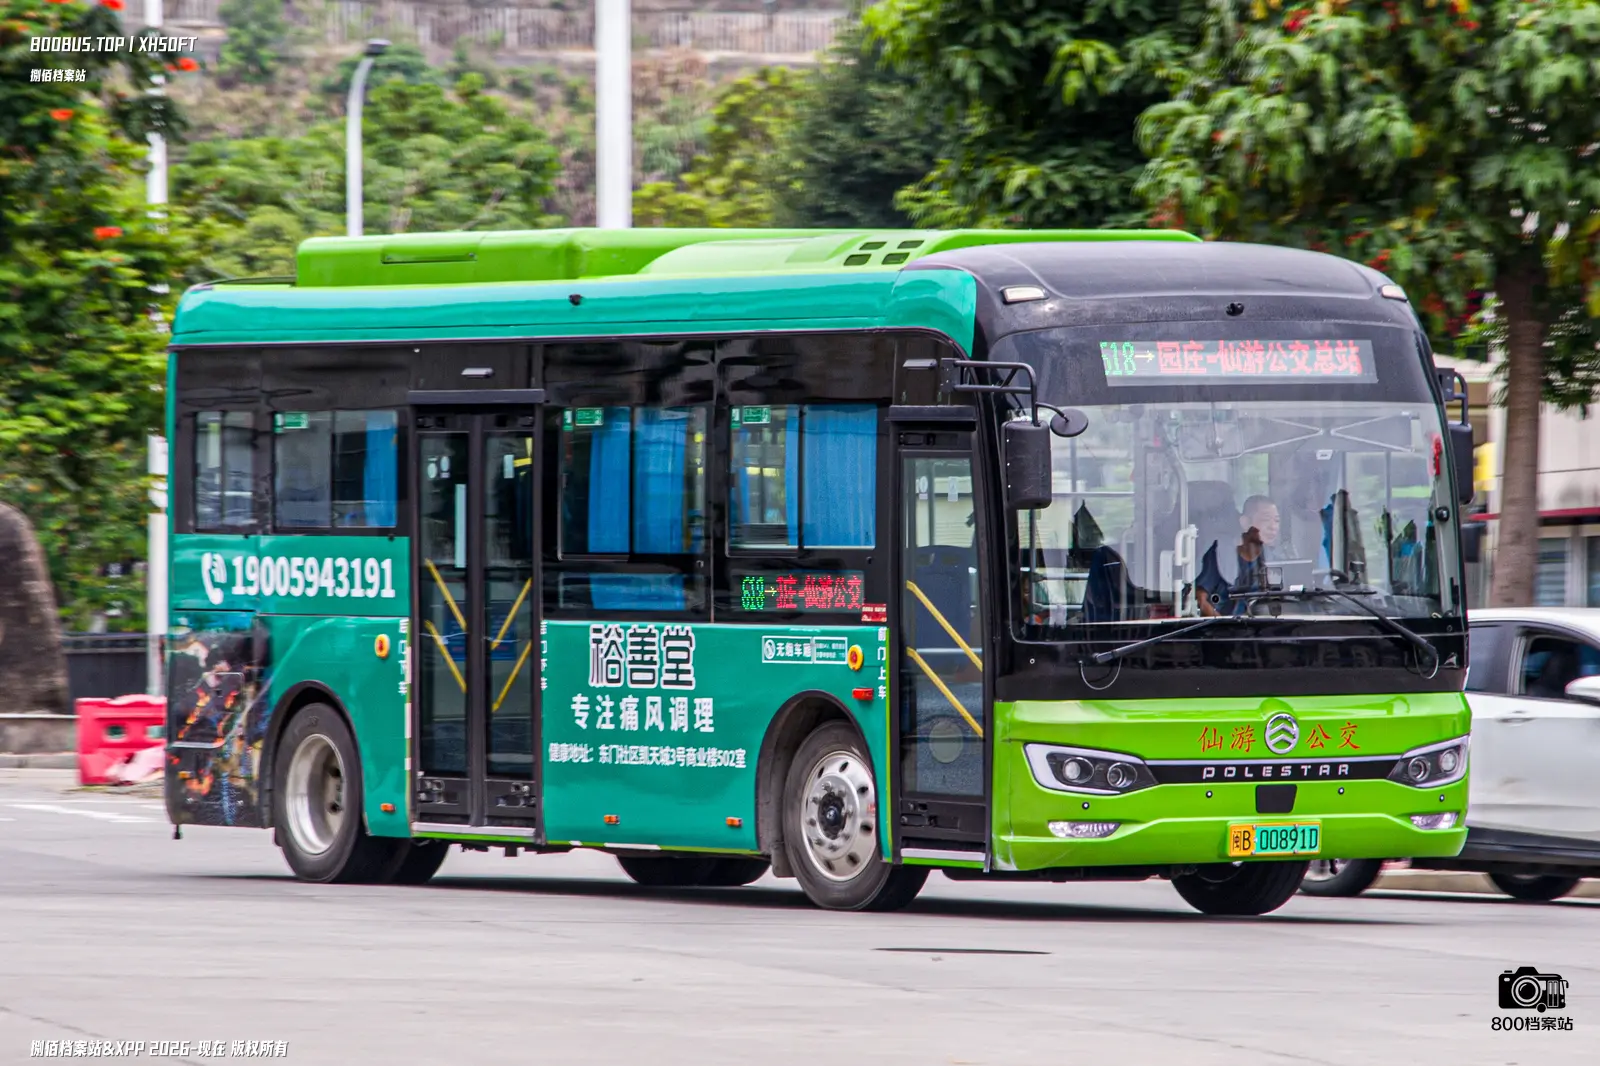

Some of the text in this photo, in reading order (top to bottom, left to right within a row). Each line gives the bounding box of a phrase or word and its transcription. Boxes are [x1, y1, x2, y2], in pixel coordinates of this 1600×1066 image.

[232, 555, 396, 598] 19005943191
[588, 623, 696, 690] 裕善堂
[570, 693, 715, 733] 专注痛风调理
[1197, 721, 1361, 753] 仙游 公交
[1202, 763, 1350, 779] POLESTAR
[1260, 828, 1319, 851] 00891D
